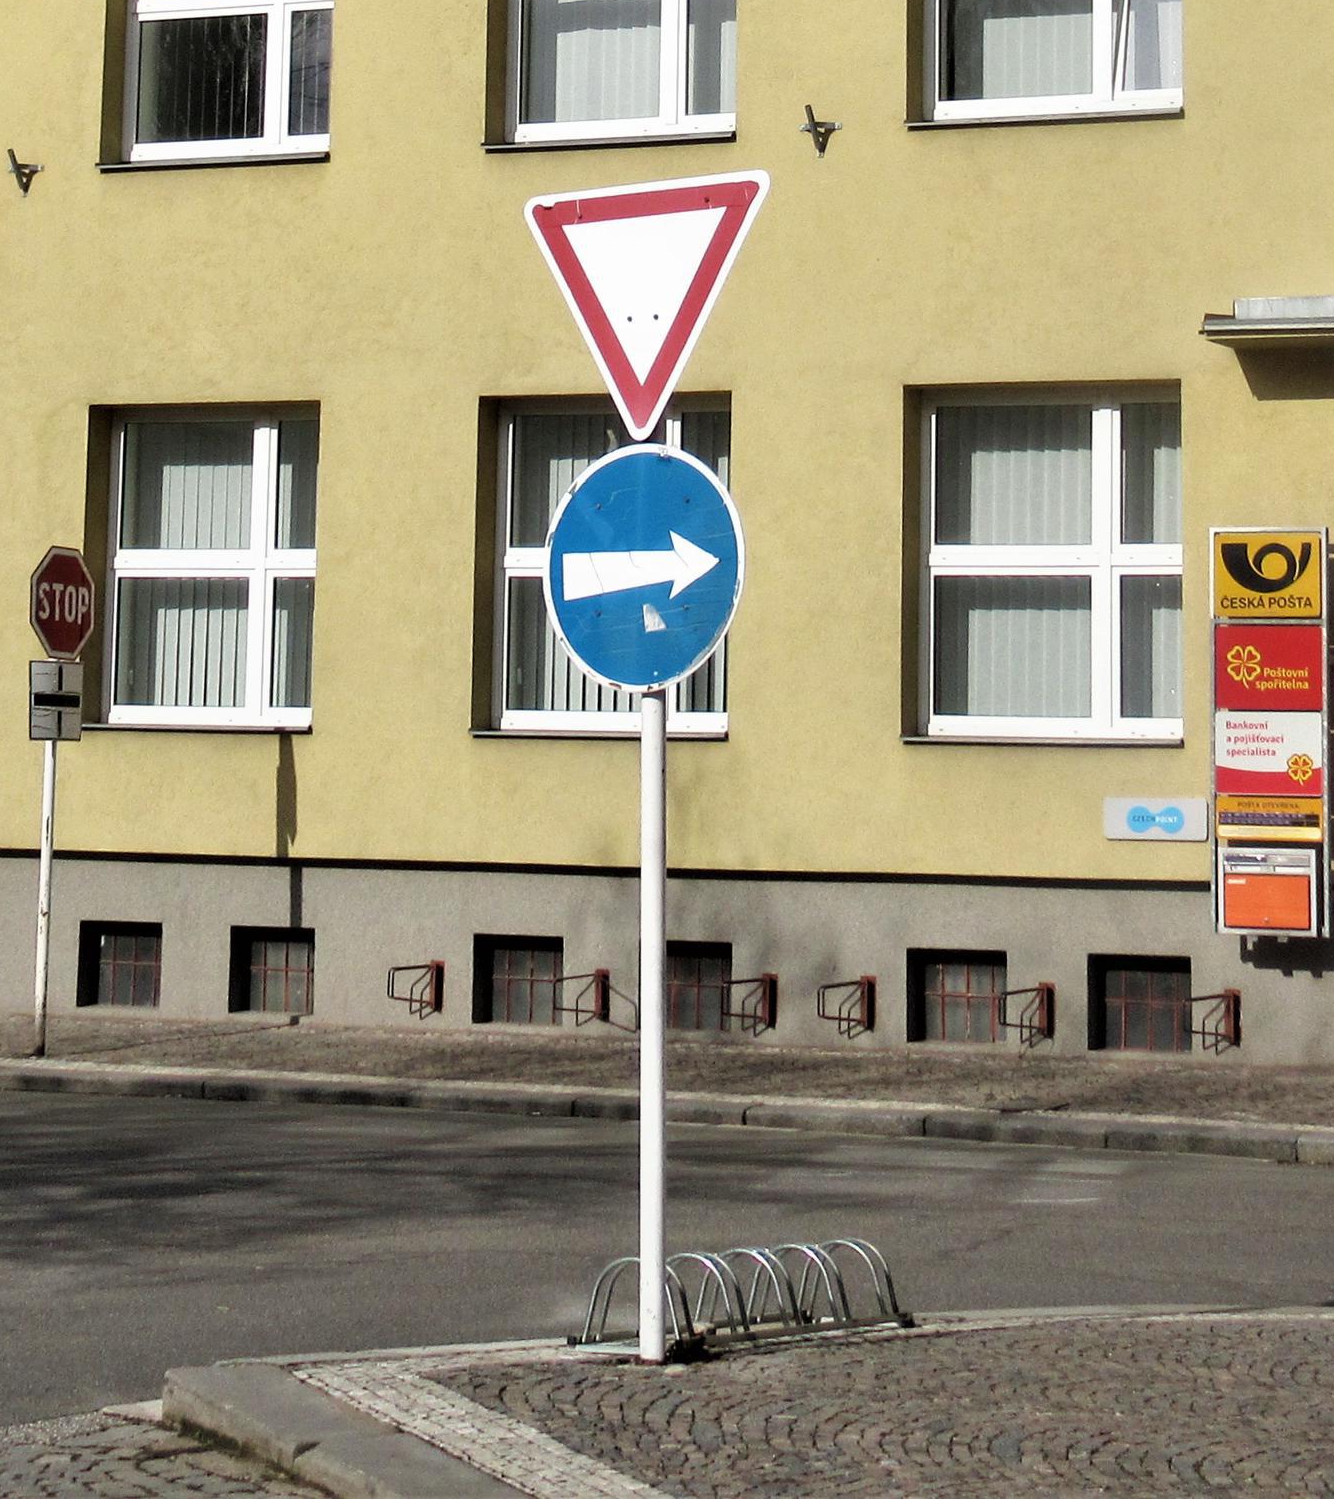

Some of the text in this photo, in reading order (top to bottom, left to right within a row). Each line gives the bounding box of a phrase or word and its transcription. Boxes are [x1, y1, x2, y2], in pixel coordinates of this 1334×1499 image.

[38, 581, 90, 625] STOP
[1220, 594, 1313, 609] ČESKÁ POŠTA
[1263, 666, 1309, 677] Poštovní
[1255, 678, 1309, 691] spořitelna
[1226, 735, 1232, 743] a
[1226, 747, 1277, 758] specialista
